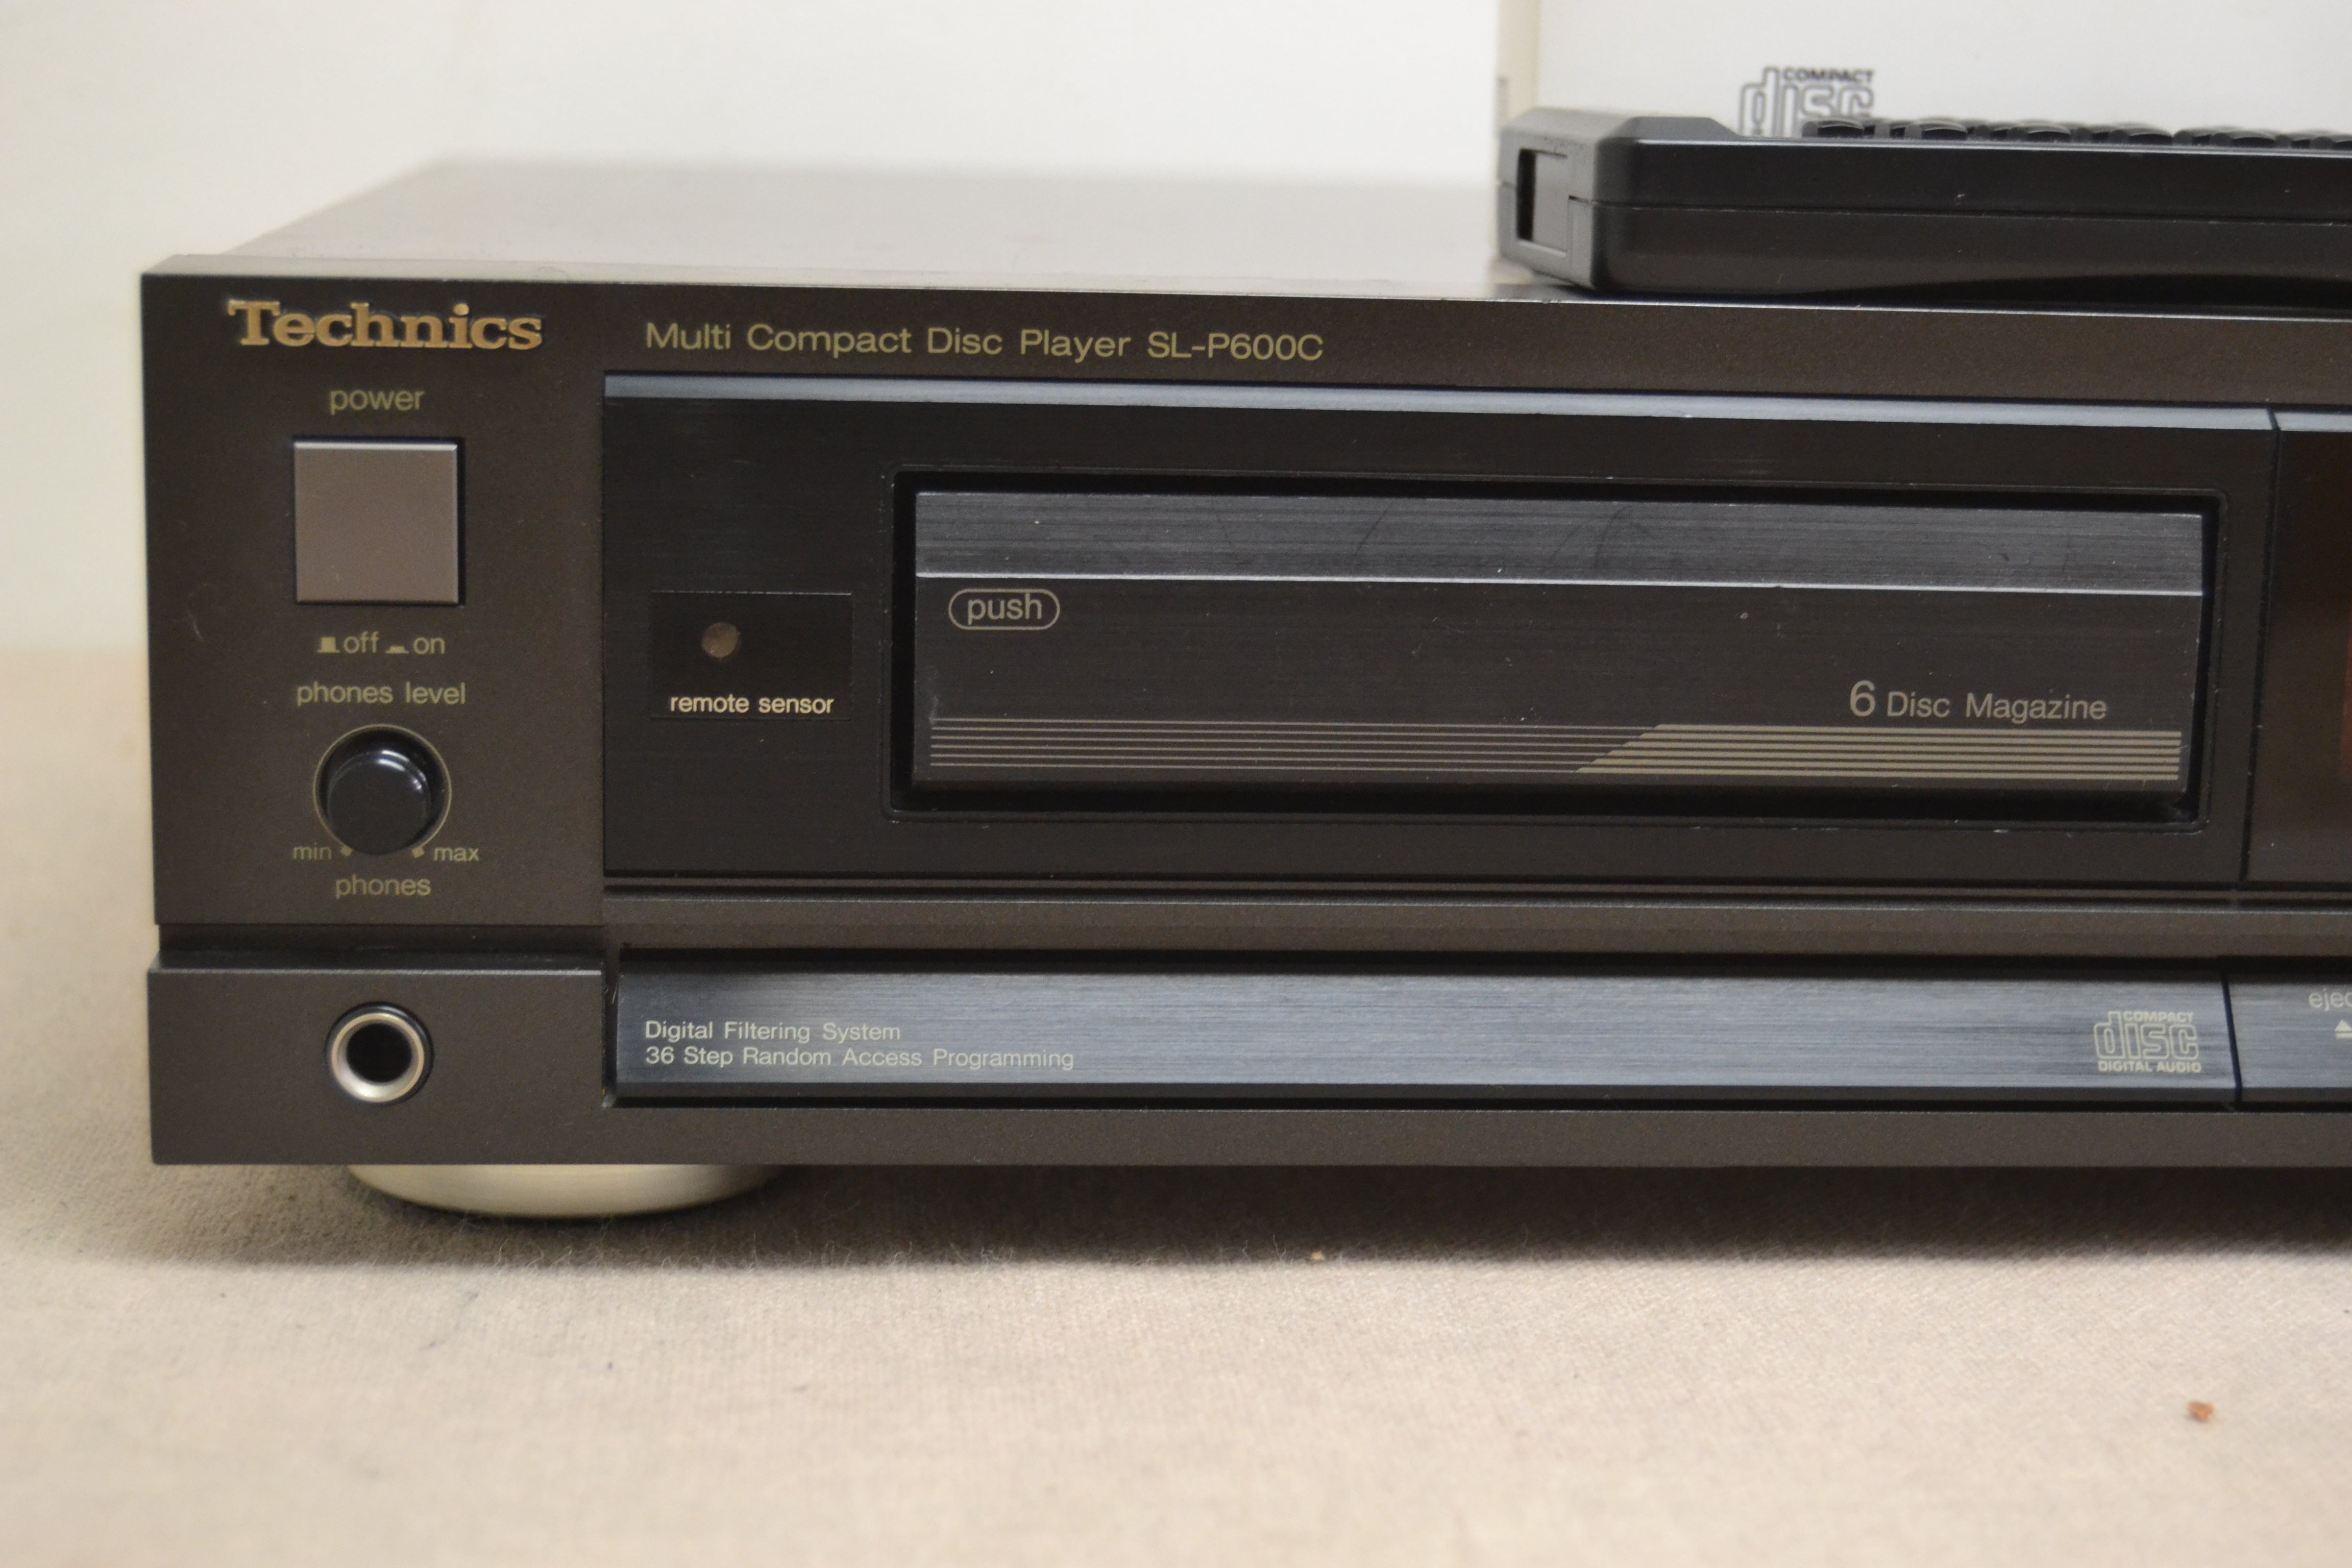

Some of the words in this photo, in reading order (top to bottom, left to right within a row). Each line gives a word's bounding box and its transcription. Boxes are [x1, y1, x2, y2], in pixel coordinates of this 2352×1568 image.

[1783, 67, 1874, 83] COMPACT
[228, 300, 543, 350] Technics
[645, 321, 731, 351] Multi
[746, 323, 912, 355] Compact
[926, 327, 1003, 356] Disc
[1020, 329, 1131, 363] Player
[1146, 331, 1325, 362] SL-P600C
[329, 389, 425, 415] power
[967, 592, 1043, 625] push
[344, 631, 380, 654] off
[413, 636, 445, 655] on
[297, 681, 394, 706] phones
[405, 682, 466, 705] level
[670, 694, 749, 713] remote
[758, 695, 835, 714] sensor
[1849, 679, 1876, 717] 6
[1886, 691, 1951, 718] Disc
[1965, 692, 2107, 724] Magazine
[291, 842, 332, 861] min
[433, 846, 479, 862] max
[335, 874, 432, 899] phones
[2122, 1011, 2194, 1022] COMPACT
[645, 1020, 714, 1041] Digital
[724, 1022, 811, 1042] Filtering
[822, 1022, 900, 1043] System
[2094, 1011, 2199, 1060] disc
[645, 1047, 675, 1065] 36
[684, 1047, 733, 1067] Step
[743, 1047, 831, 1066] Random
[842, 1048, 922, 1067] Access
[934, 1049, 1074, 1071] Programming
[2098, 1061, 2152, 1072] DIGITAL
[2157, 1061, 2201, 1073] AUDIO
